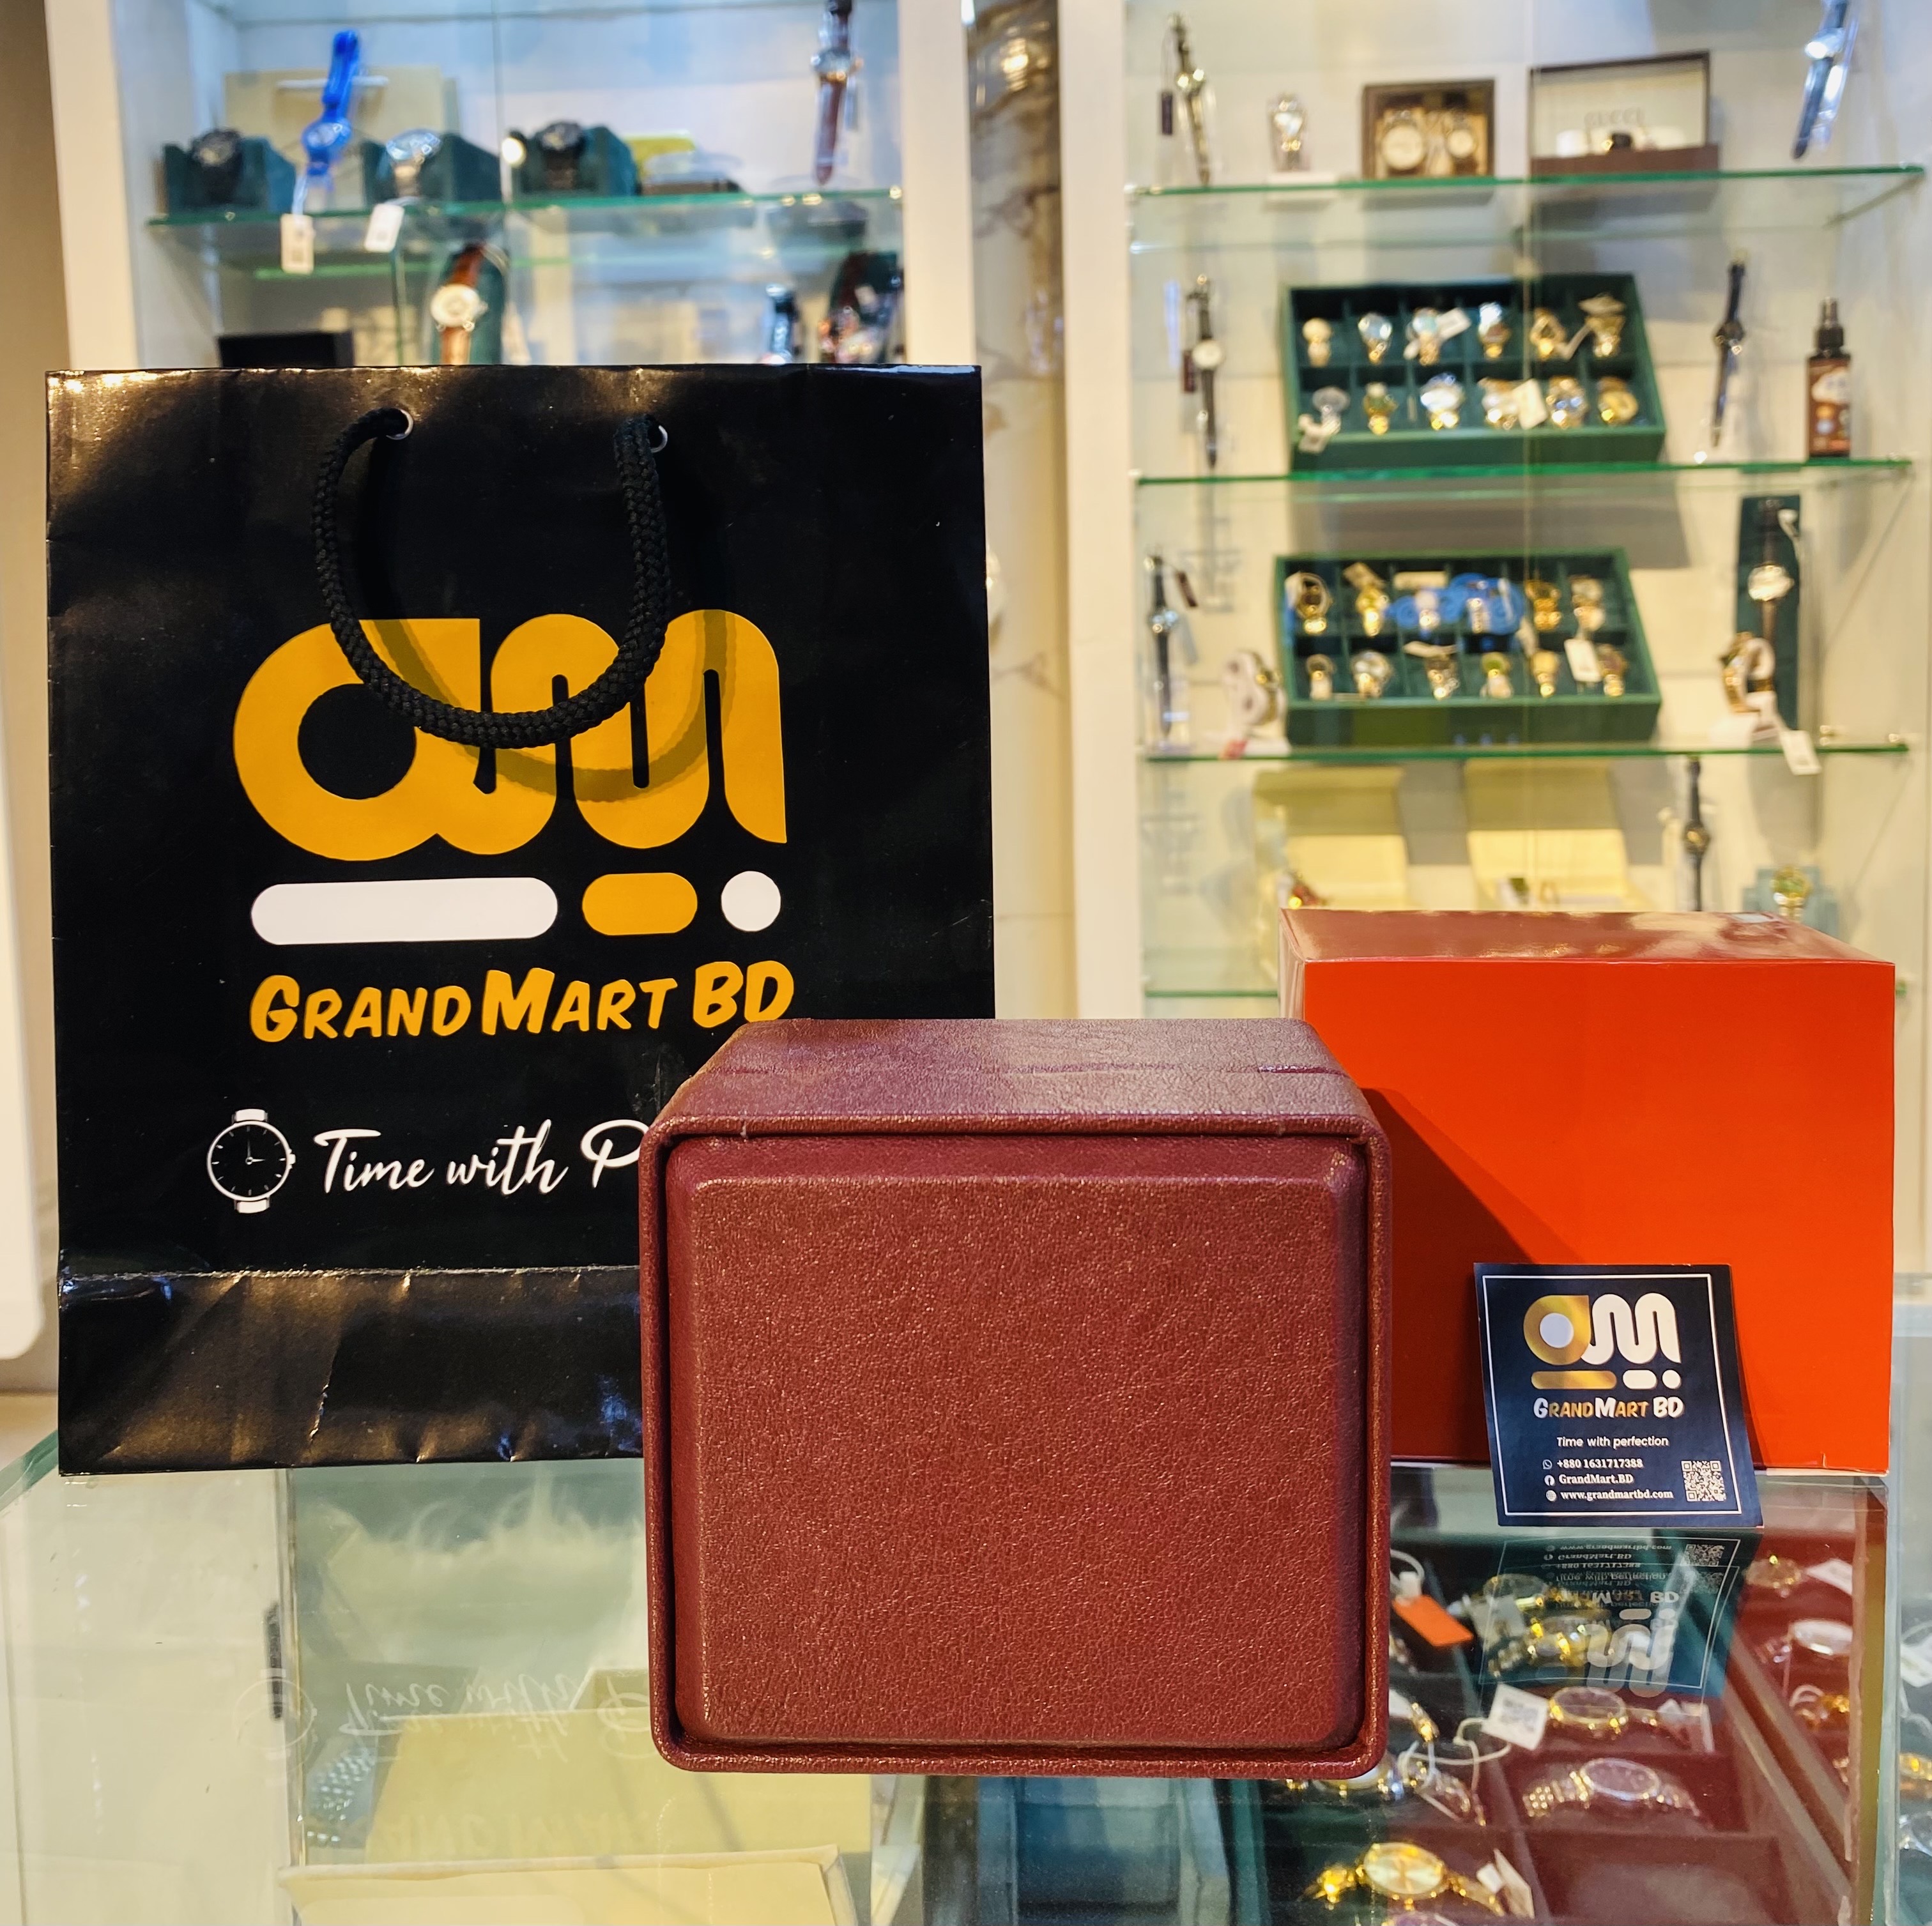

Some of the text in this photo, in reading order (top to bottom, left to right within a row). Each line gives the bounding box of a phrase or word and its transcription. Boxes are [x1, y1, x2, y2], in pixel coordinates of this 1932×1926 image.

[693, 960, 795, 1028] BD
[313, 1128, 433, 1193] Time
[445, 1119, 570, 1196] with
[1653, 1396, 1685, 1419] BD
[1556, 1435, 1670, 1450] Time with perfection
[1556, 1458, 1644, 1469] +880 1631717388
[1558, 1473, 1634, 1485] GrandMart.BD
[1560, 1488, 1674, 1501] www.grandmartbd.com
